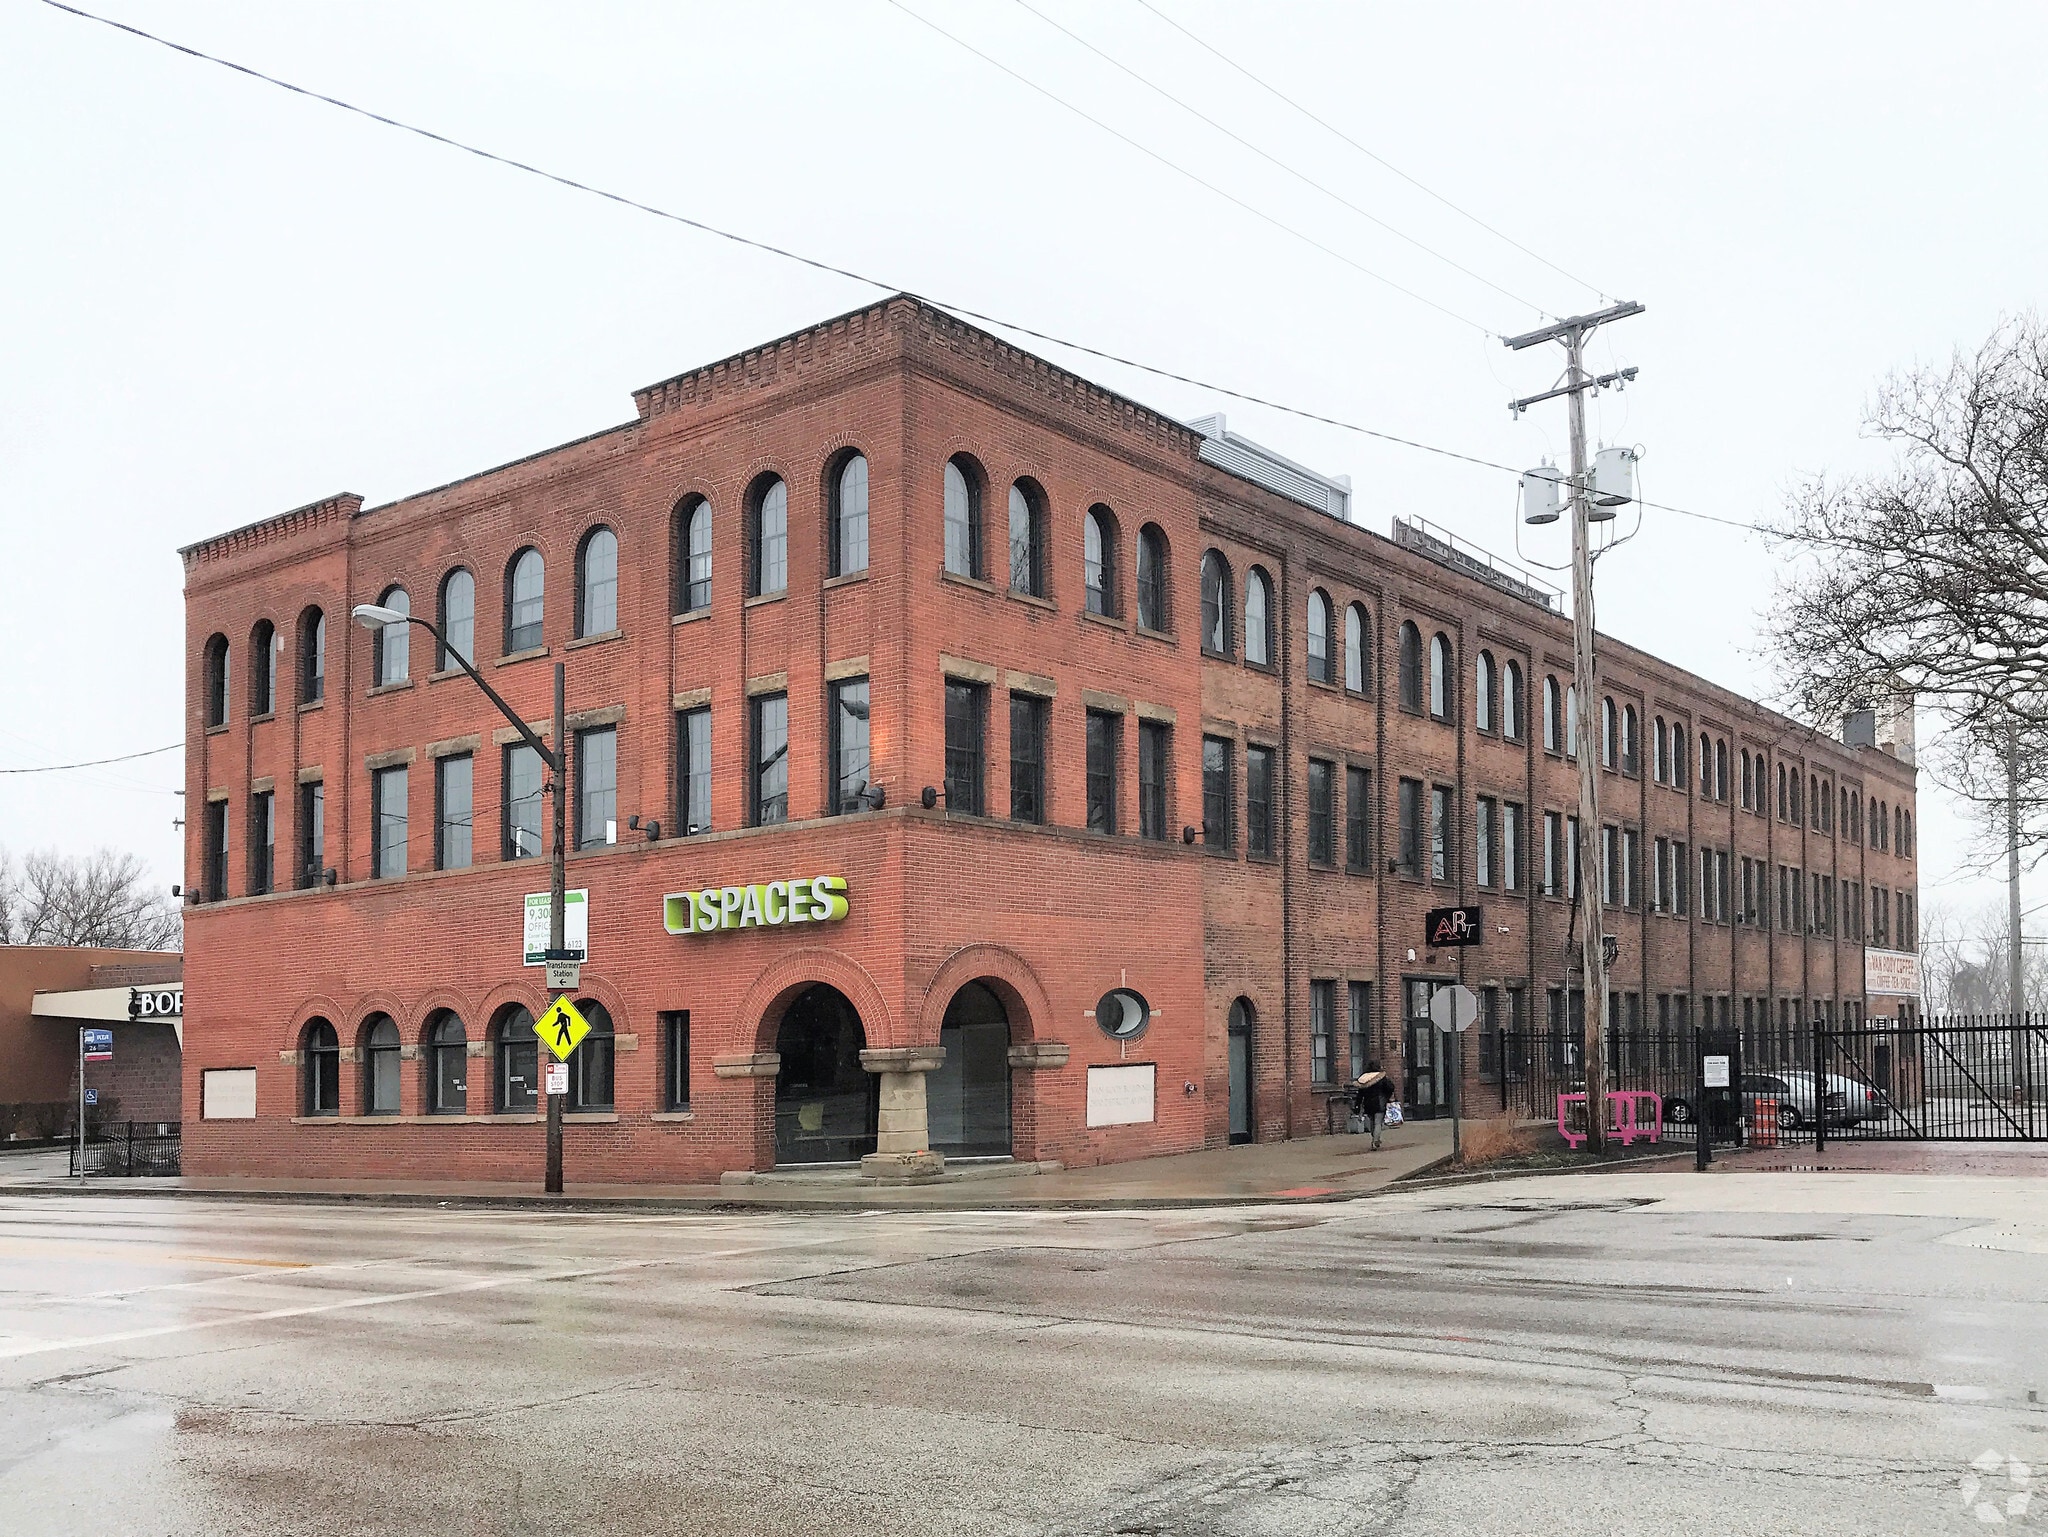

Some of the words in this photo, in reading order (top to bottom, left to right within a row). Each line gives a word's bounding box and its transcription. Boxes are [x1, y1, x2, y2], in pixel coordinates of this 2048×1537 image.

[528, 898, 539, 906] FOR
[698, 876, 836, 932] SPACES
[529, 908, 552, 921] 9,30
[1432, 910, 1477, 942] ART
[567, 940, 582, 949] 6123
[546, 961, 579, 969] Transformer
[553, 970, 573, 978] Station
